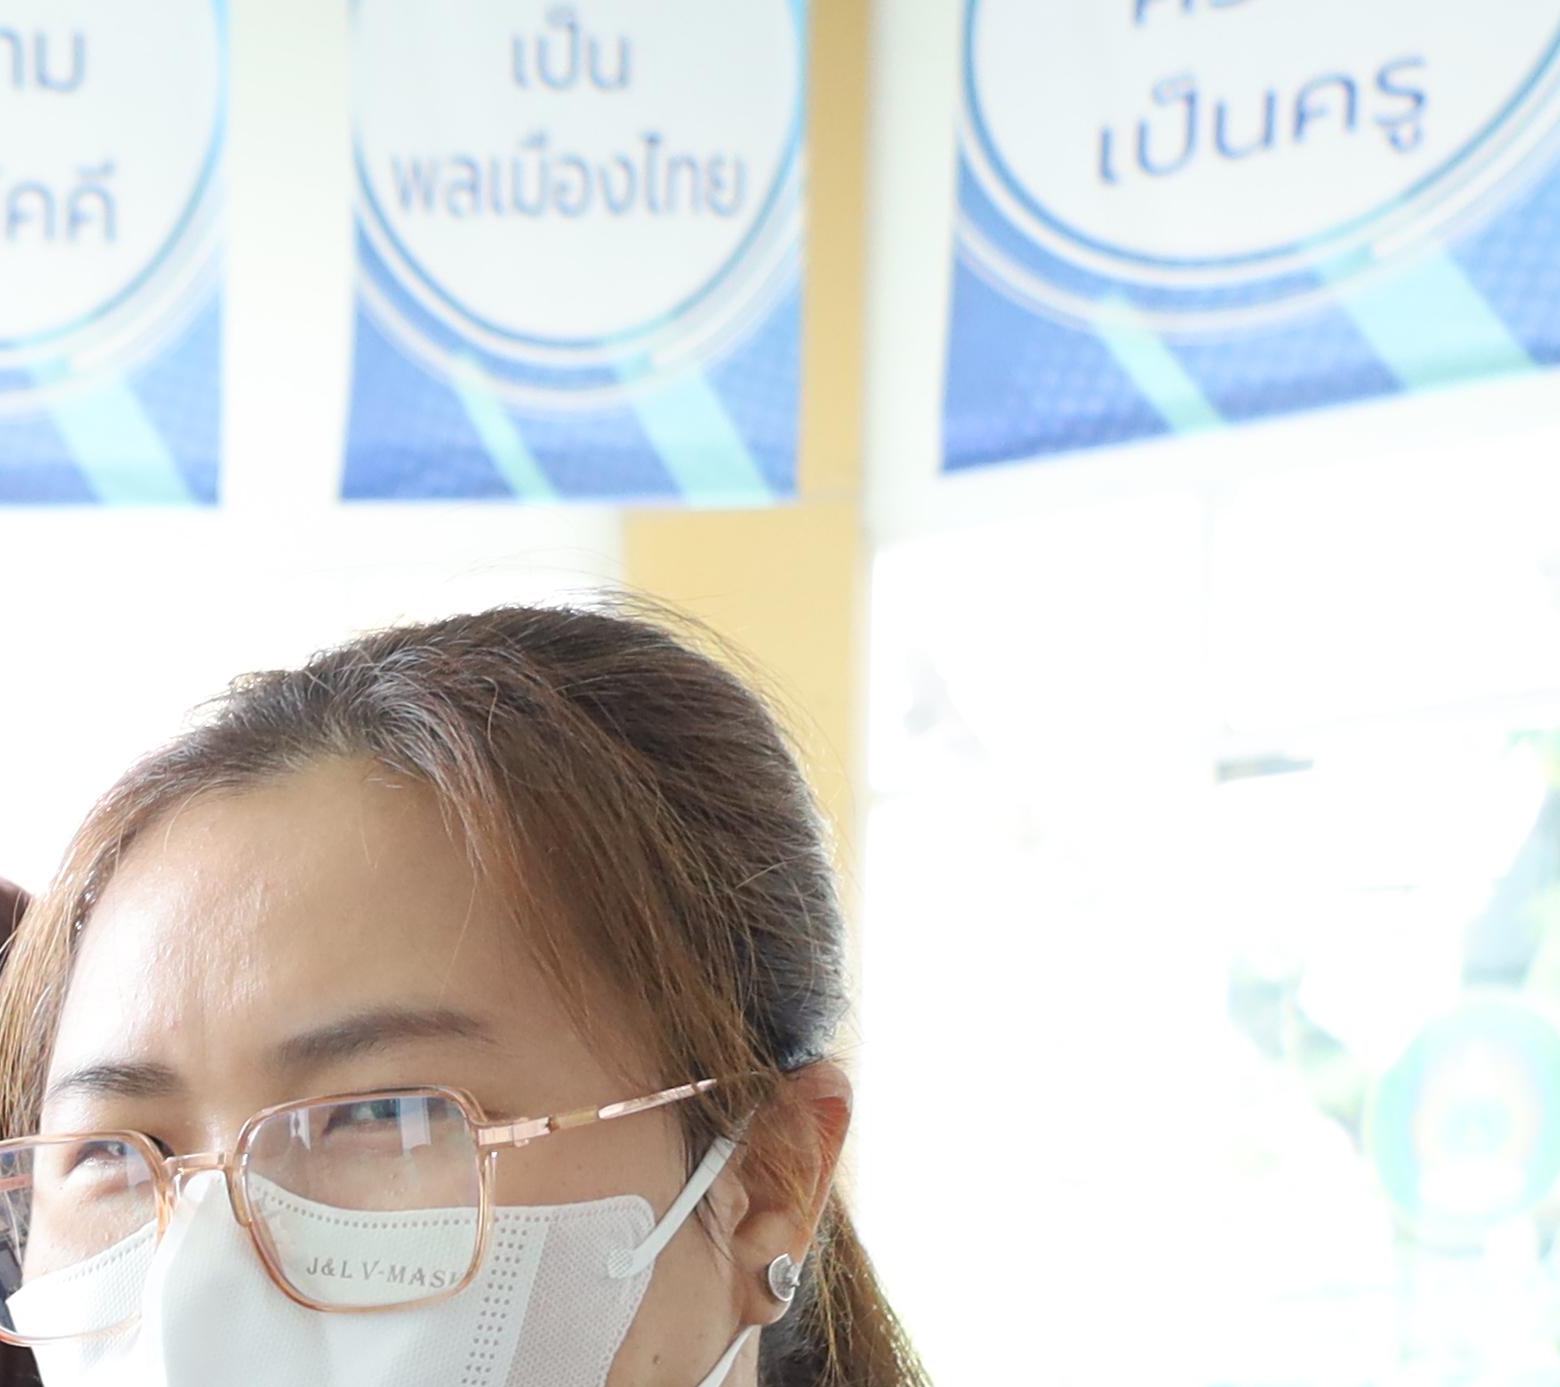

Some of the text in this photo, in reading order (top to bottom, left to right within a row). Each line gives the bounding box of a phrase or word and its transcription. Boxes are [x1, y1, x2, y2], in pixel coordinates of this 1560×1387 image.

[510, 2, 633, 92] เป็น
[1095, 51, 1431, 185] เป็นครู
[391, 132, 748, 220] พลเมืองไทย
[306, 1257, 353, 1279] J&L
